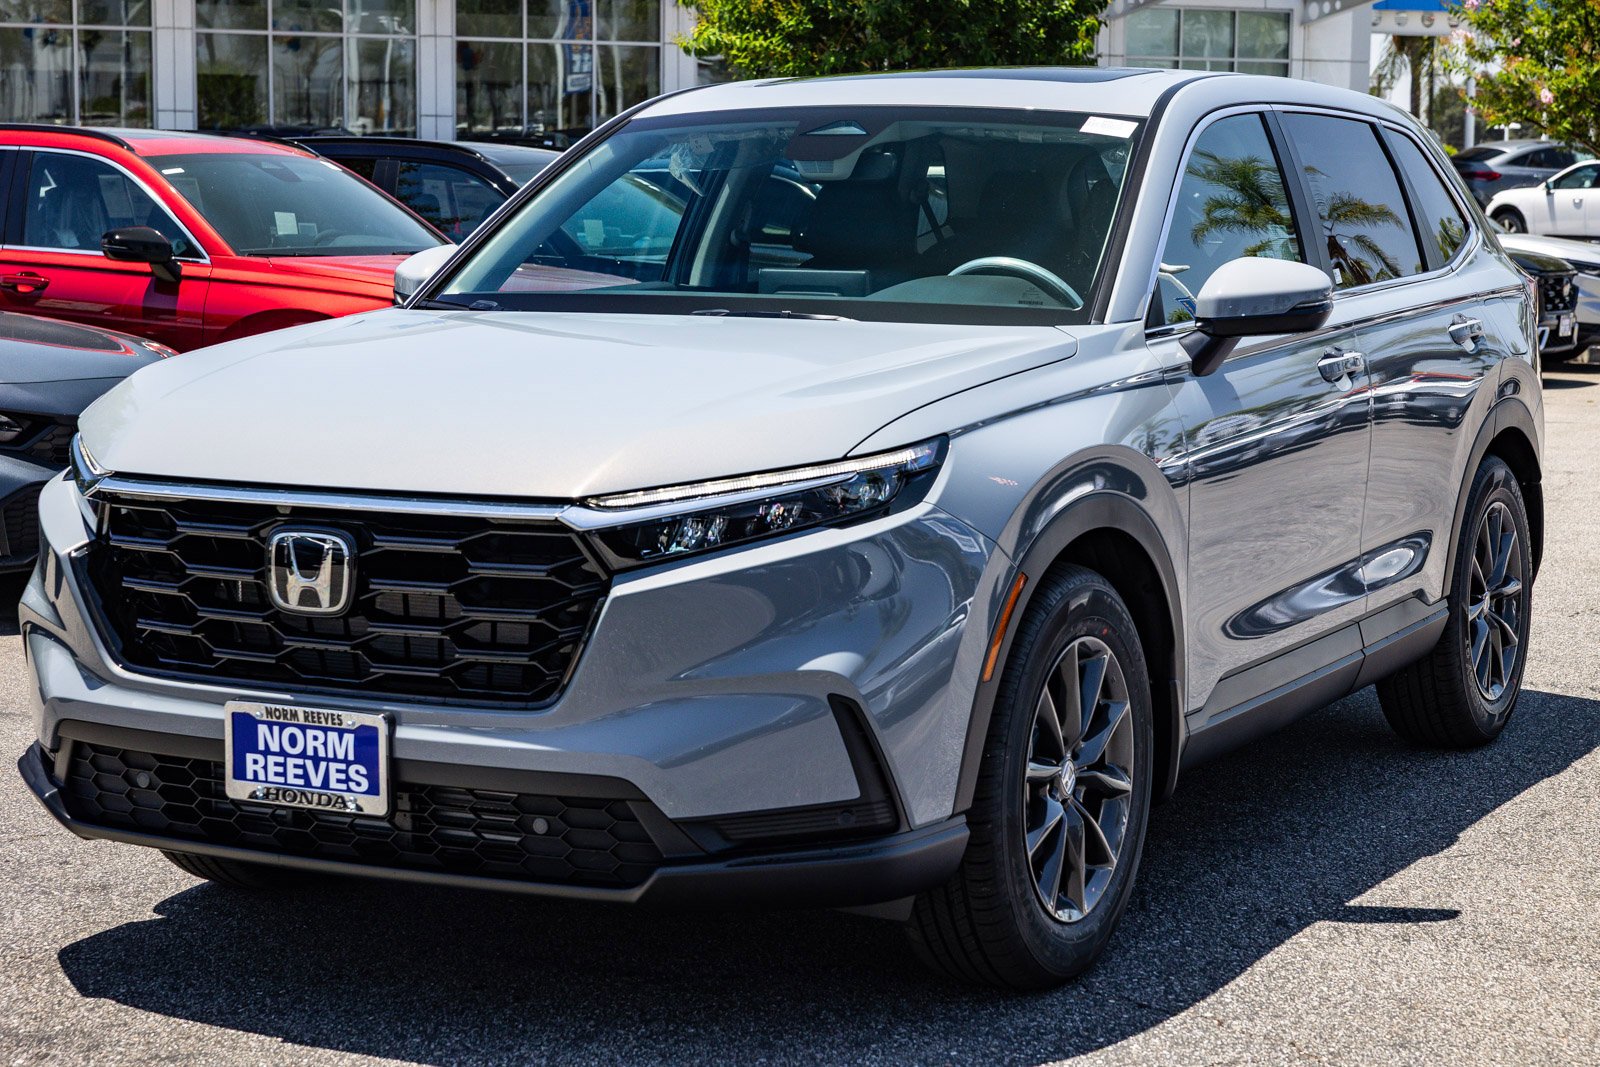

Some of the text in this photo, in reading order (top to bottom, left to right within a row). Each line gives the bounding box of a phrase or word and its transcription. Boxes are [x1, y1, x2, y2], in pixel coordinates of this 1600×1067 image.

[265, 707, 343, 726] NORM REEVES
[258, 725, 354, 760] NORM
[246, 754, 369, 792] REEVES
[264, 786, 348, 809] HONDA
